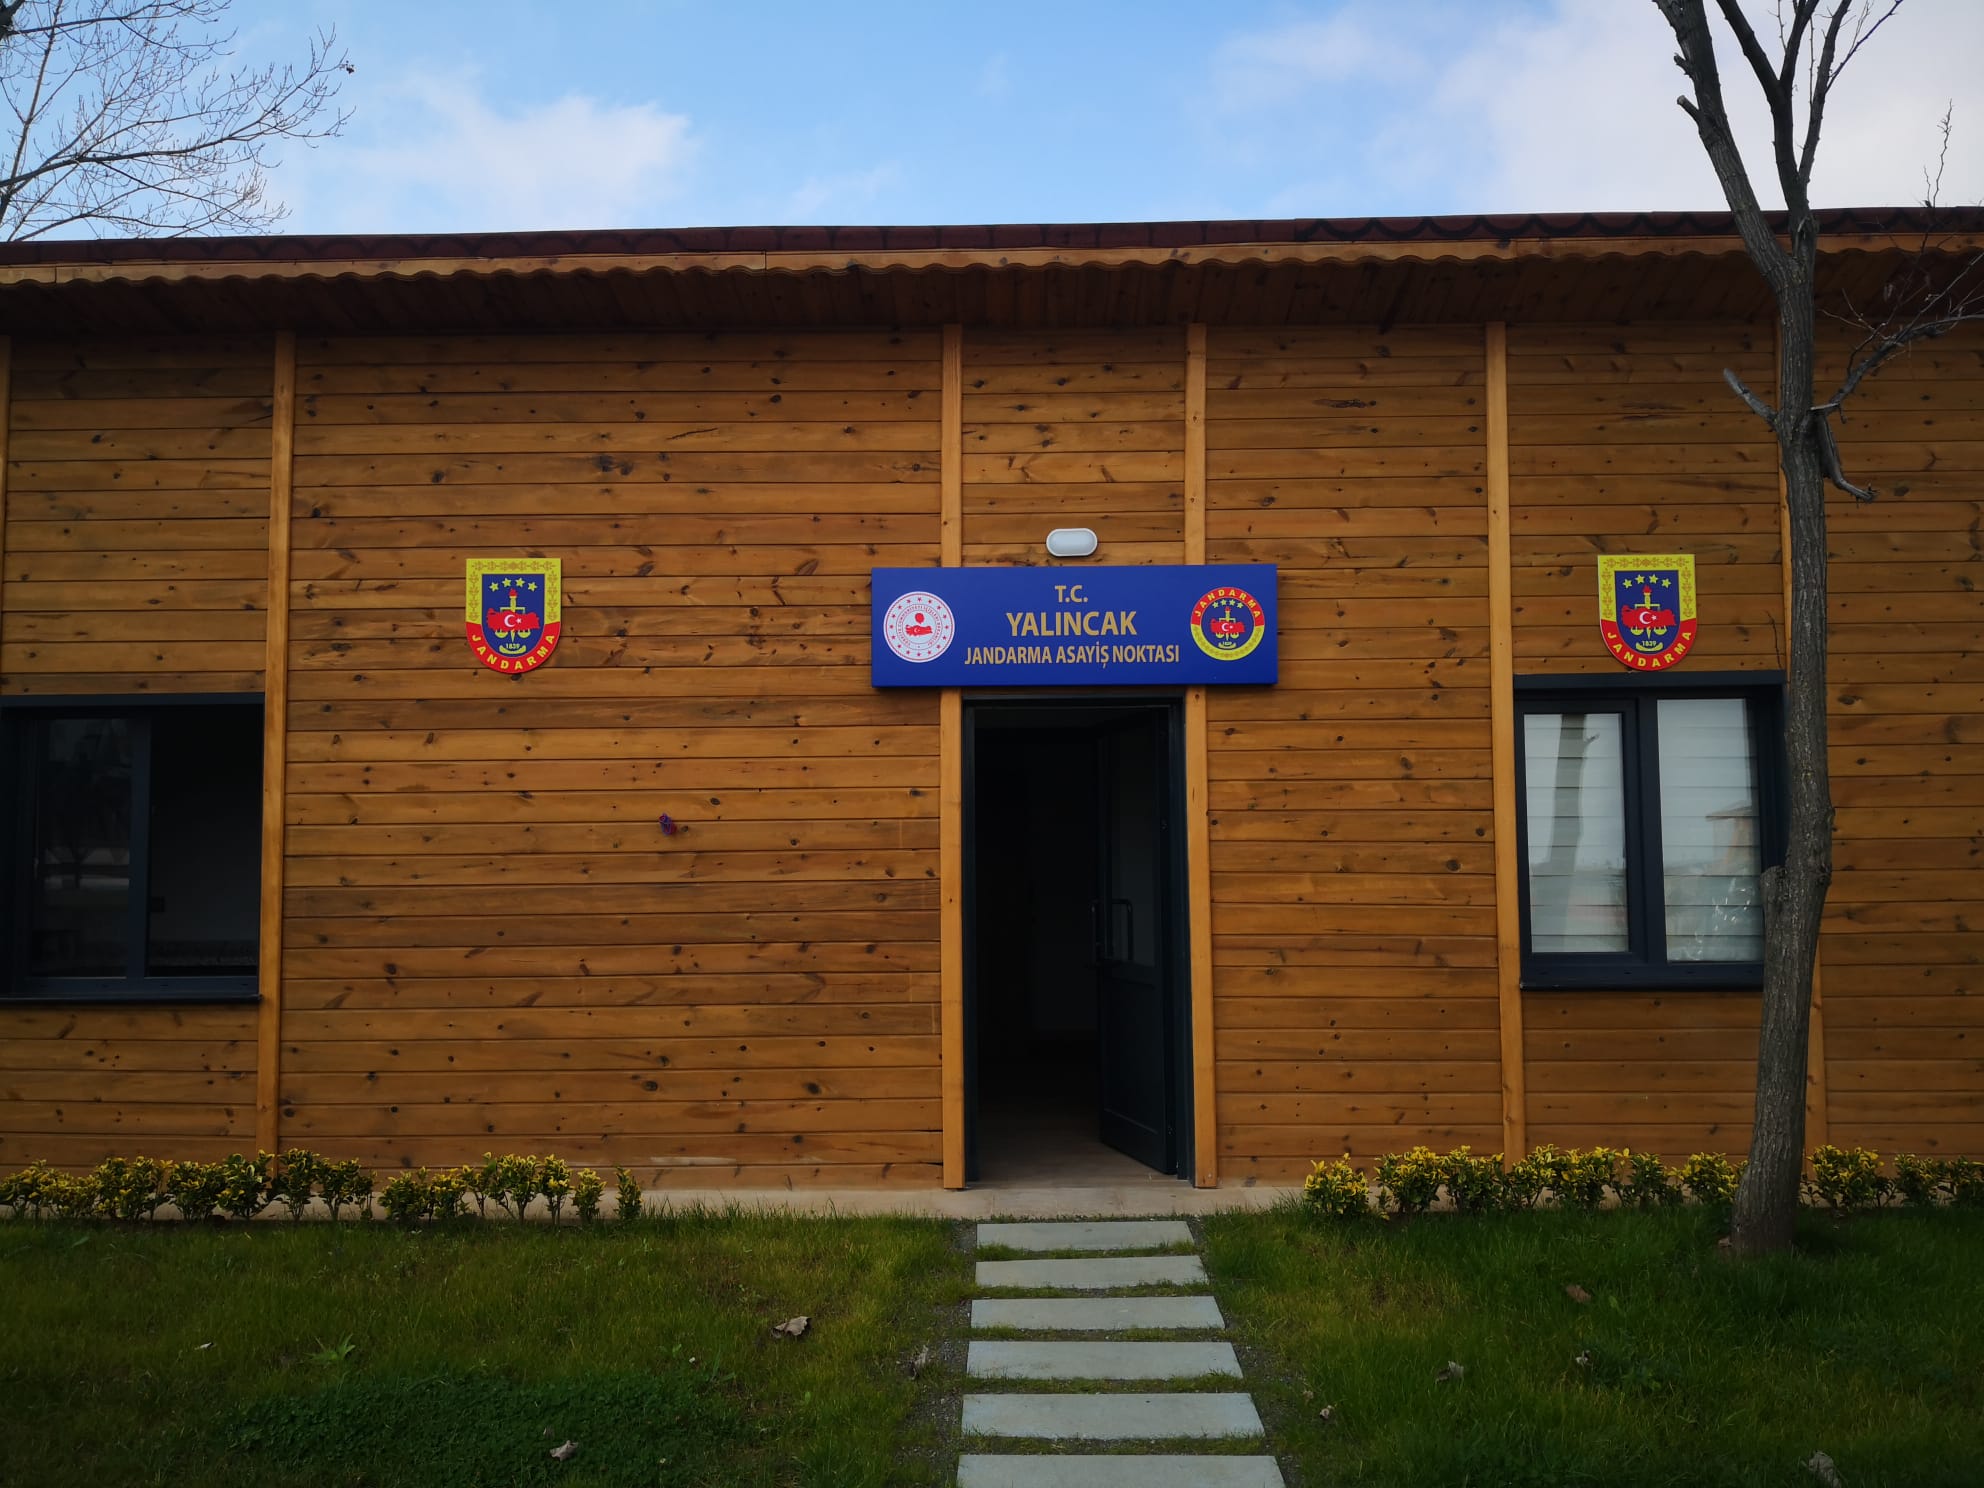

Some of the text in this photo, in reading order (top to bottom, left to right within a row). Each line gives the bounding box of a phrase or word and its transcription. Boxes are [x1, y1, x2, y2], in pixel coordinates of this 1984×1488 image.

[1055, 585, 1088, 602] T.C.
[1194, 589, 1261, 618] JANDARMA
[1006, 611, 1137, 636] YALINCAK
[472, 634, 555, 670] JANDARMA
[964, 641, 1179, 668] JANDARMA ASAYİŞ NOKTASI
[1607, 631, 1691, 667] JANDARMA
